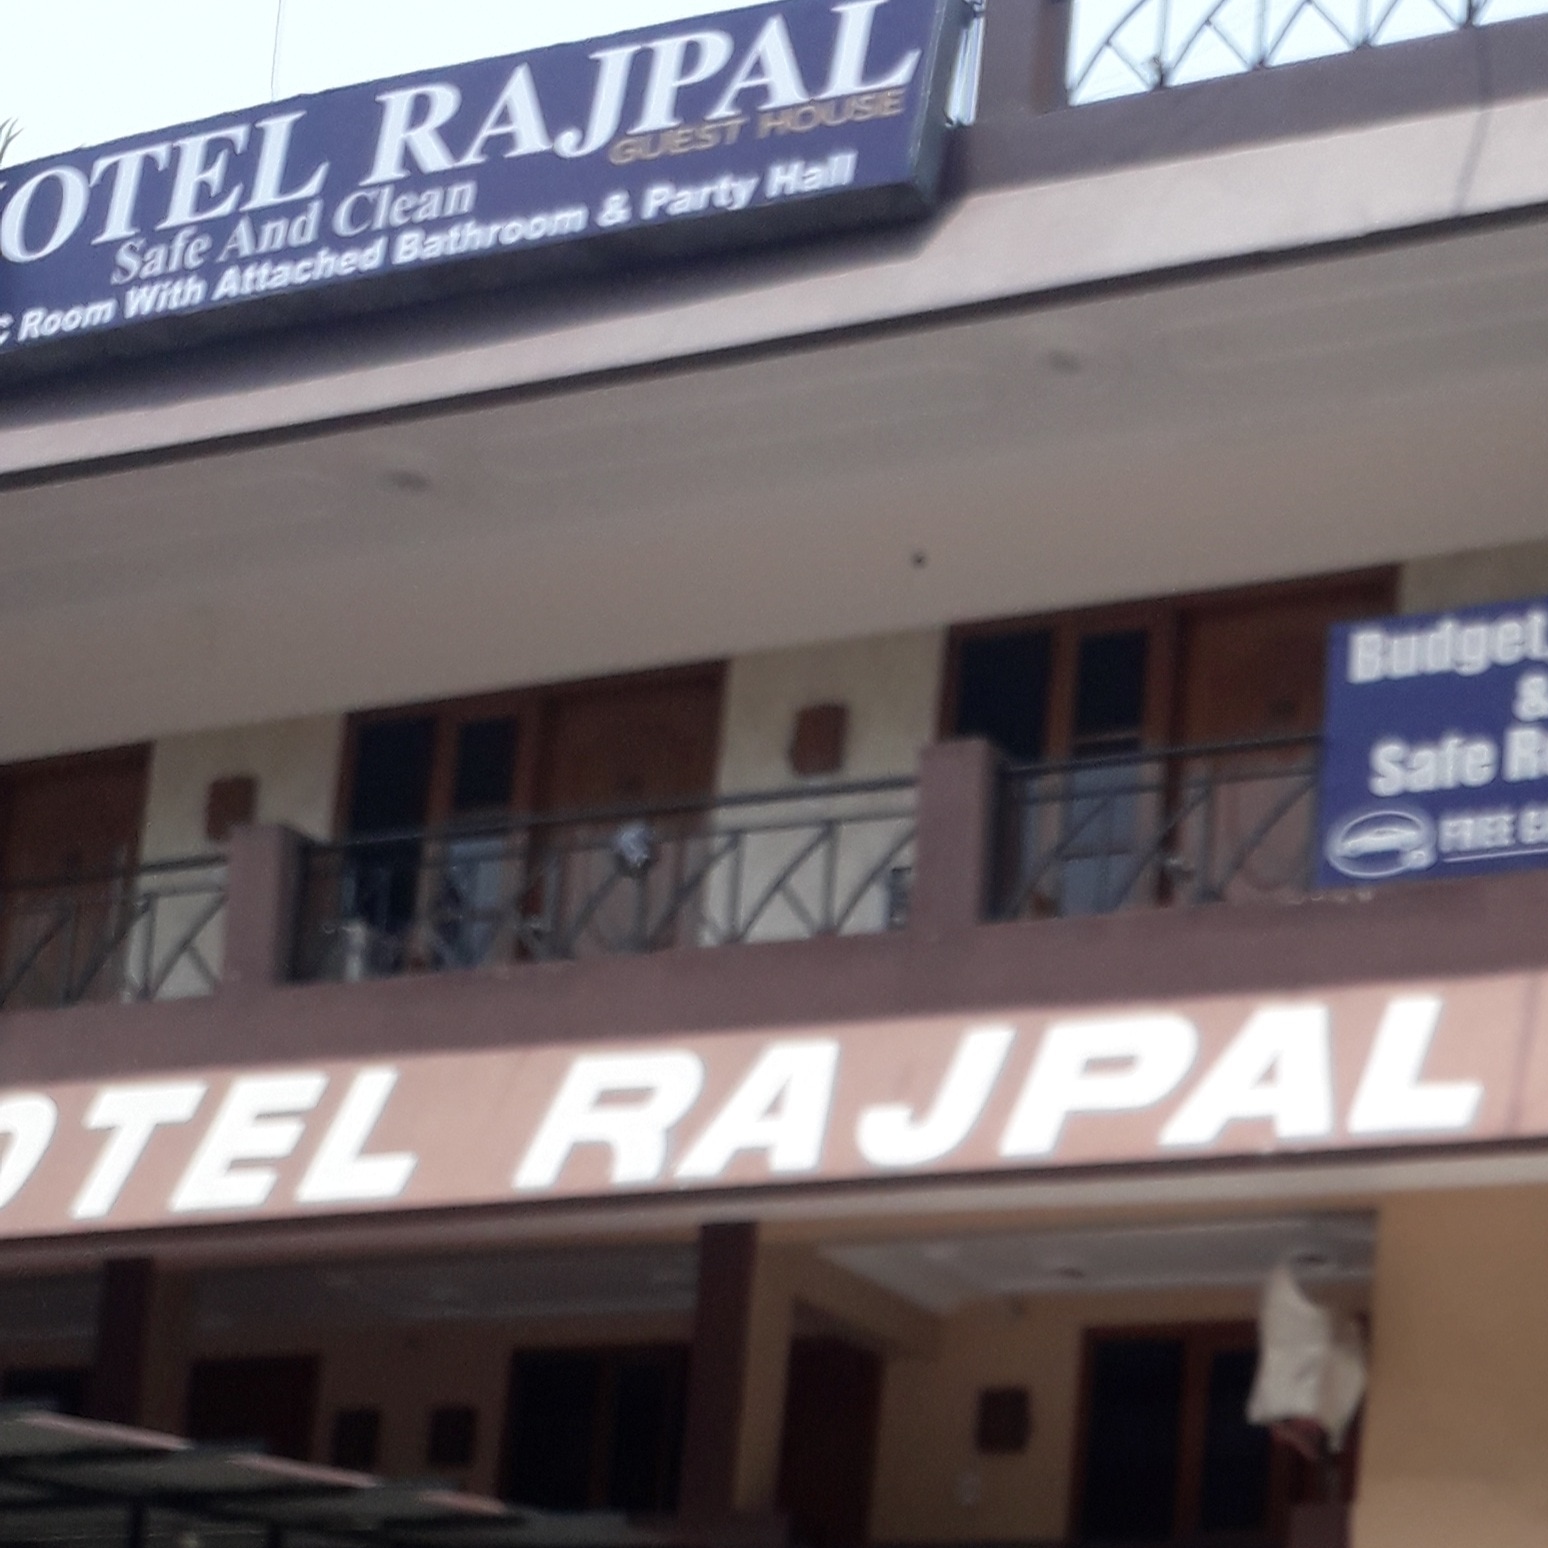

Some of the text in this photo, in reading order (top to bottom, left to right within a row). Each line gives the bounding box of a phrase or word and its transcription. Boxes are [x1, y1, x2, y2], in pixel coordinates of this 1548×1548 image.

[0, 0, 923, 264] OTEL RAJPAL
[607, 88, 907, 166] GUEST HOUSE
[17, 299, 118, 342] Room
[123, 273, 209, 319] With
[212, 237, 389, 302] Attached
[391, 203, 590, 266] Bathroom
[596, 191, 632, 227] &
[640, 171, 760, 219] Party
[764, 149, 859, 198] Hall
[110, 180, 478, 286] Safe And Clean
[1367, 732, 1498, 798] Safe
[512, 991, 1483, 1193] RAJPAL
